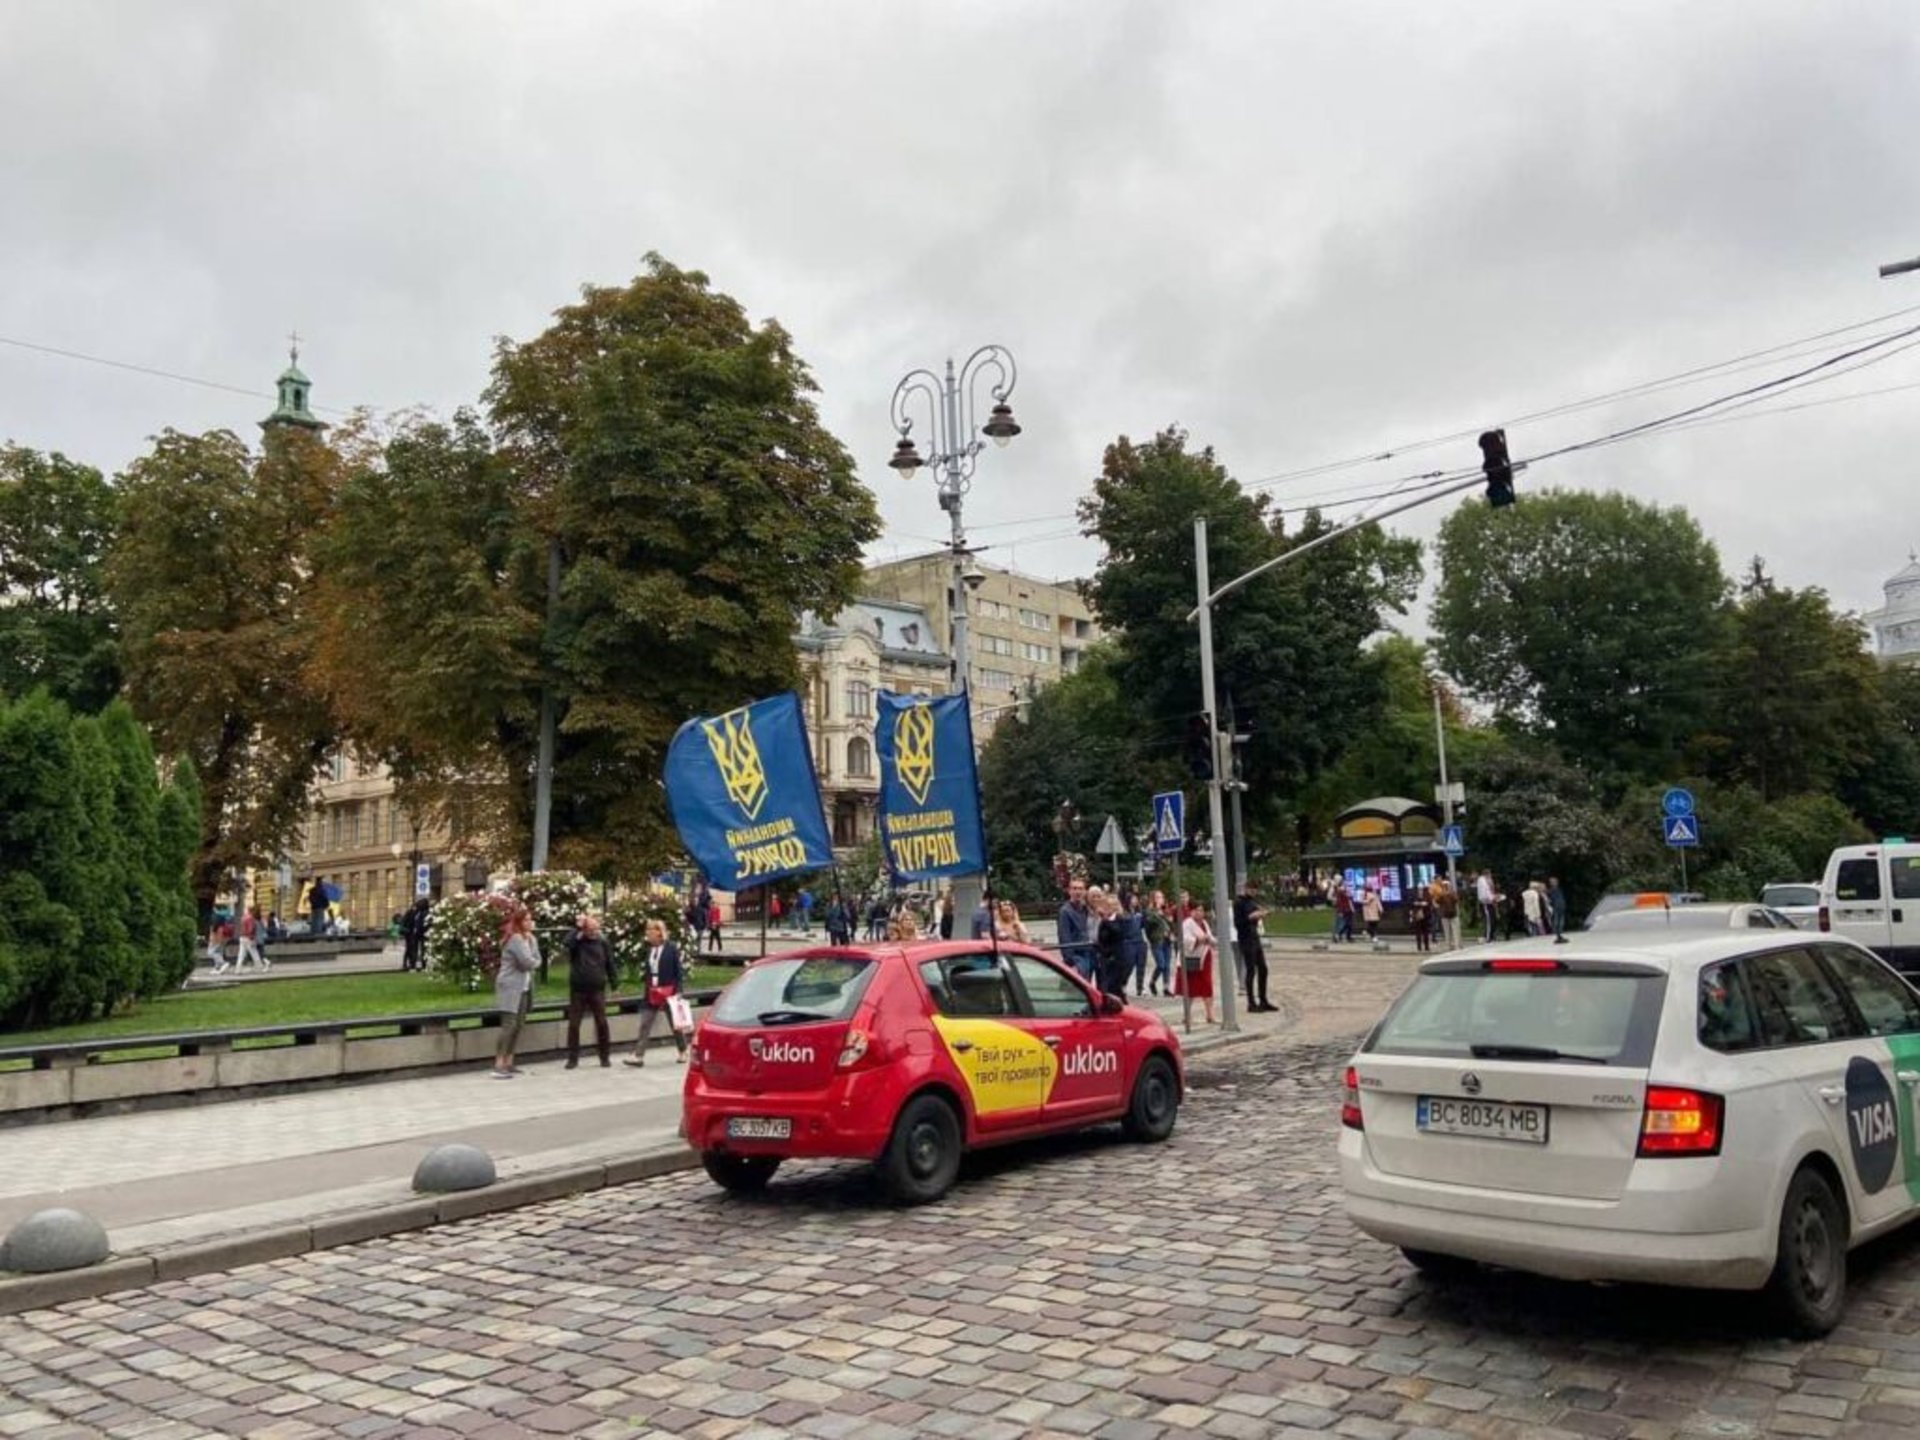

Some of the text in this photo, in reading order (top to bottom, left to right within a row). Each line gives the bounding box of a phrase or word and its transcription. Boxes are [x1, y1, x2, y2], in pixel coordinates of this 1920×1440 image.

[762, 1042, 815, 1063] uklon
[975, 1046, 1000, 1063] Твій
[1064, 1044, 1117, 1075] uklon
[1430, 1102, 1456, 1124] BC
[1460, 1104, 1505, 1129] 8034
[1510, 1110, 1538, 1132] MB
[1851, 1100, 1896, 1148] VISA
